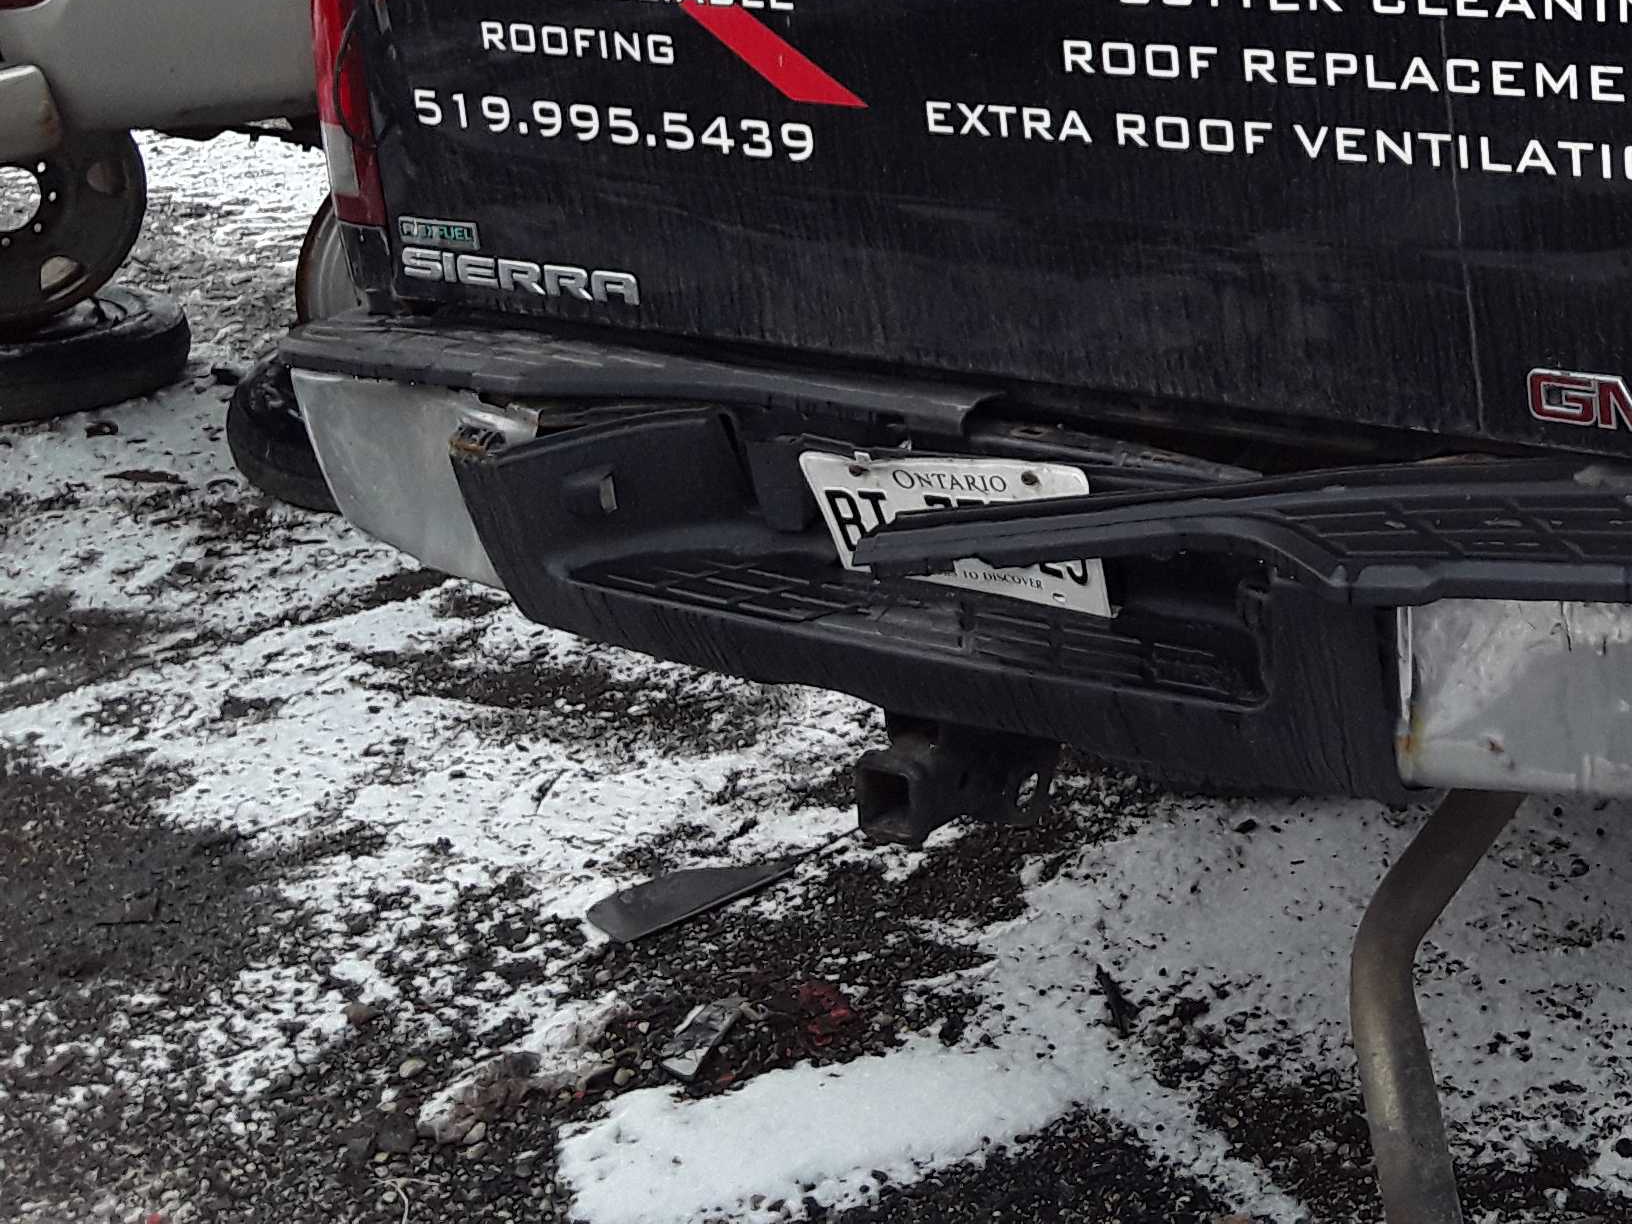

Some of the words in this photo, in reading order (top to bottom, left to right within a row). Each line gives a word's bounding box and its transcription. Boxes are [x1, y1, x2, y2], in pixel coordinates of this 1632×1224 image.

[480, 21, 675, 65] ROOFING
[1063, 39, 1218, 79] ROOF
[413, 88, 815, 162] 519.995.5439
[925, 100, 1093, 143] EXTRA
[1115, 112, 1273, 154] ROOF
[401, 247, 641, 306] SIERRA
[892, 469, 1007, 493] ONTARIO
[983, 571, 1044, 590] DISCOVER
